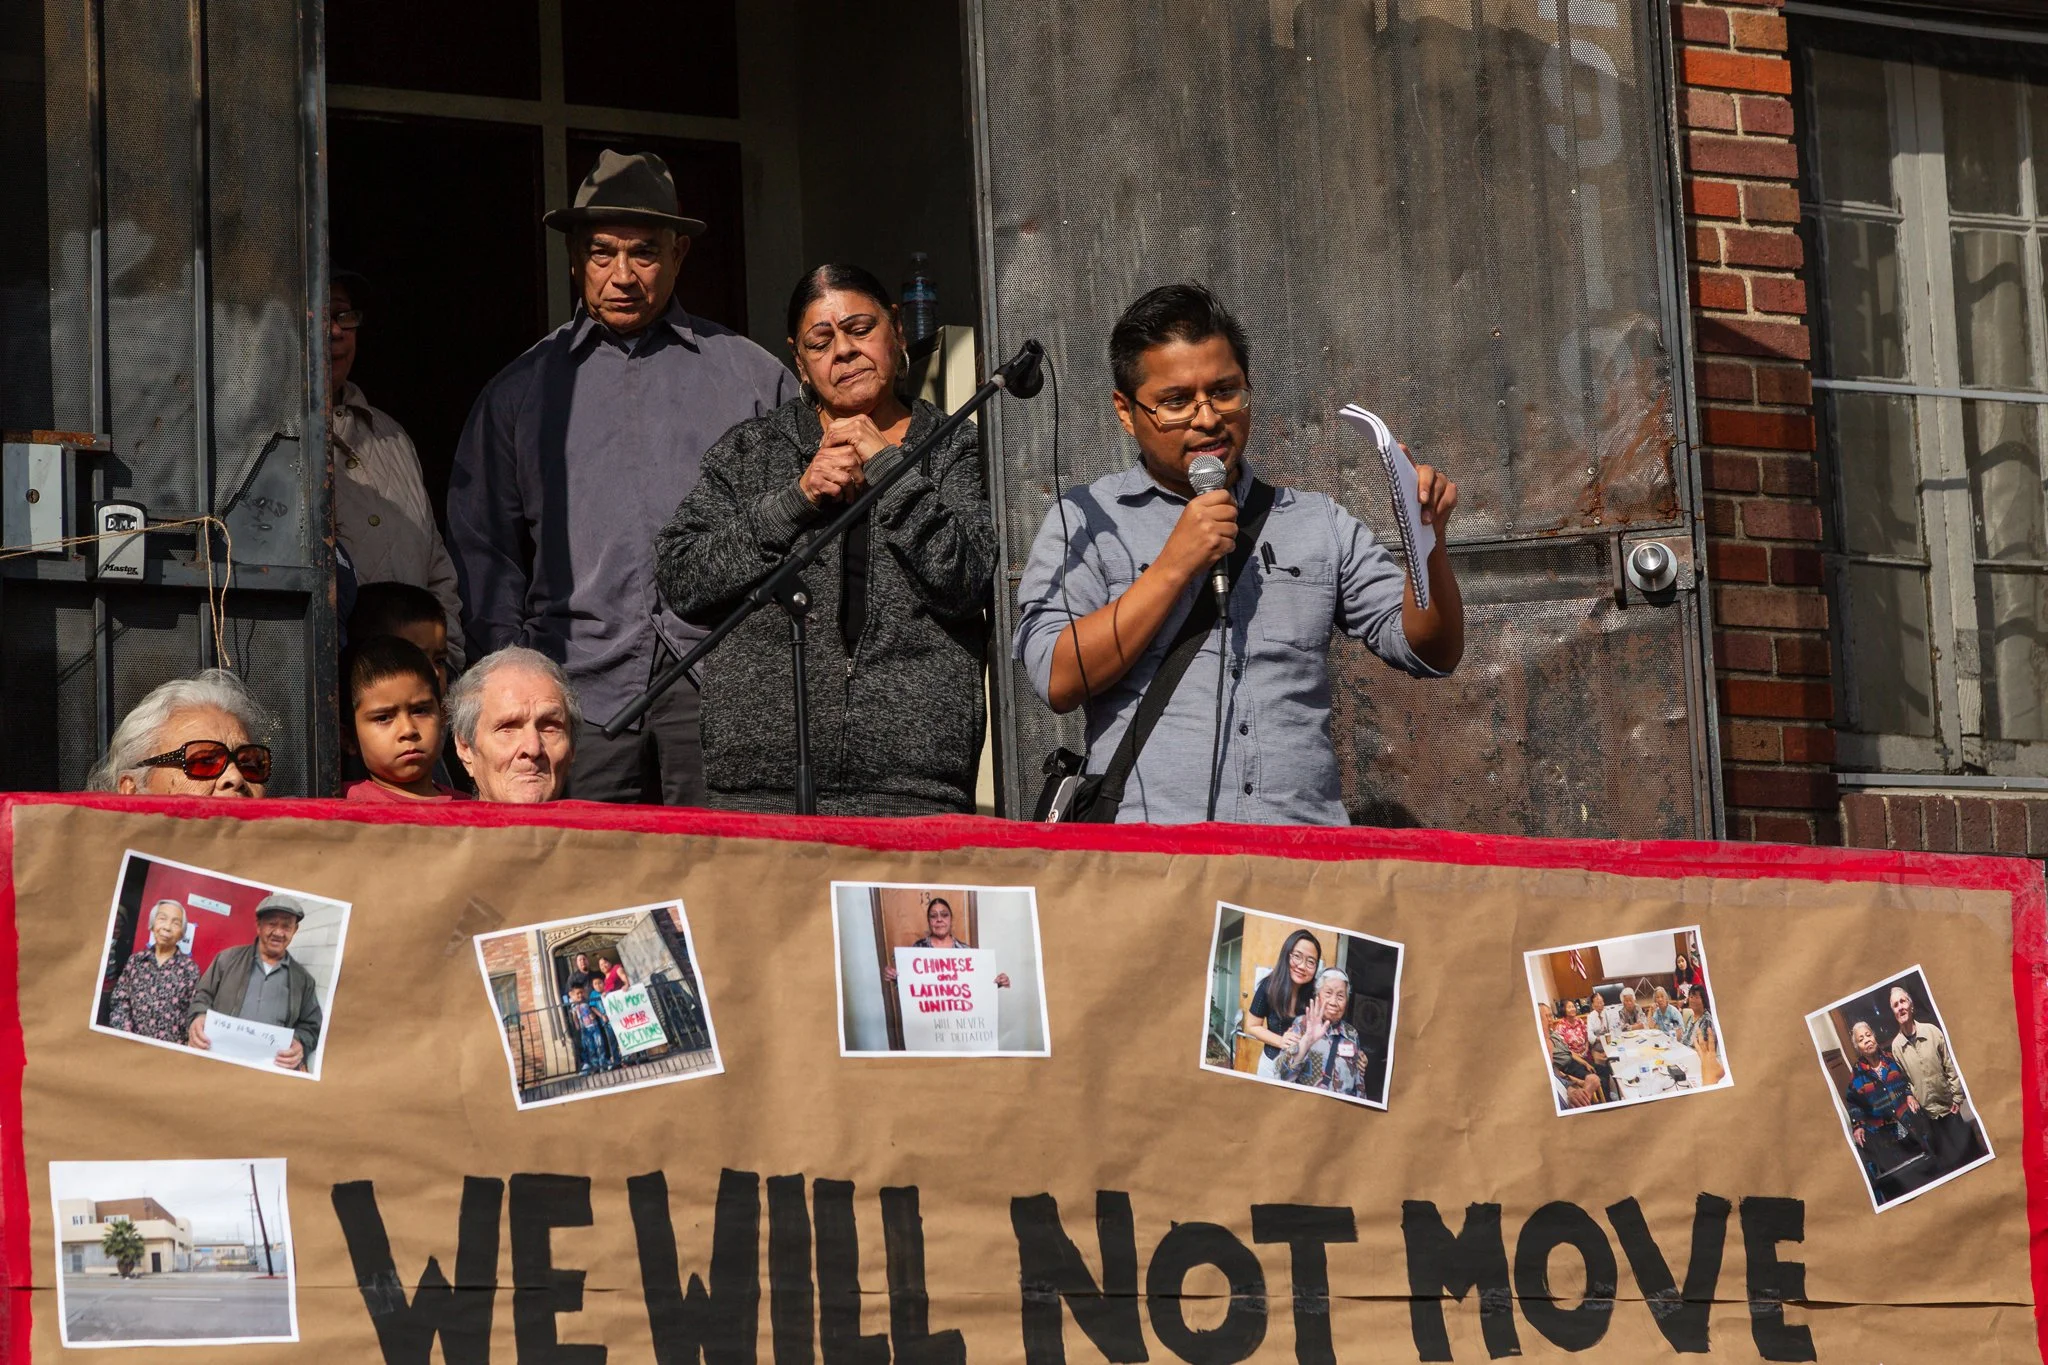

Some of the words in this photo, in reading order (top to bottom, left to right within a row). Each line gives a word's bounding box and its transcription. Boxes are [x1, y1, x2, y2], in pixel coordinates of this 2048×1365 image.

[105, 564, 138, 573] Master
[912, 957, 974, 973] CHINESE
[937, 970, 959, 981] and
[909, 984, 972, 999] LATINOS
[918, 999, 974, 1013] UNITED
[620, 1010, 651, 1028] UNFAIR
[956, 1016, 985, 1030] NEVER
[619, 1022, 663, 1048] EVICTIONS
[331, 1173, 608, 1365] WE
[626, 1168, 967, 1365] WILL
[1010, 1191, 1358, 1365] NOT
[1401, 1192, 1818, 1363] MOVE
